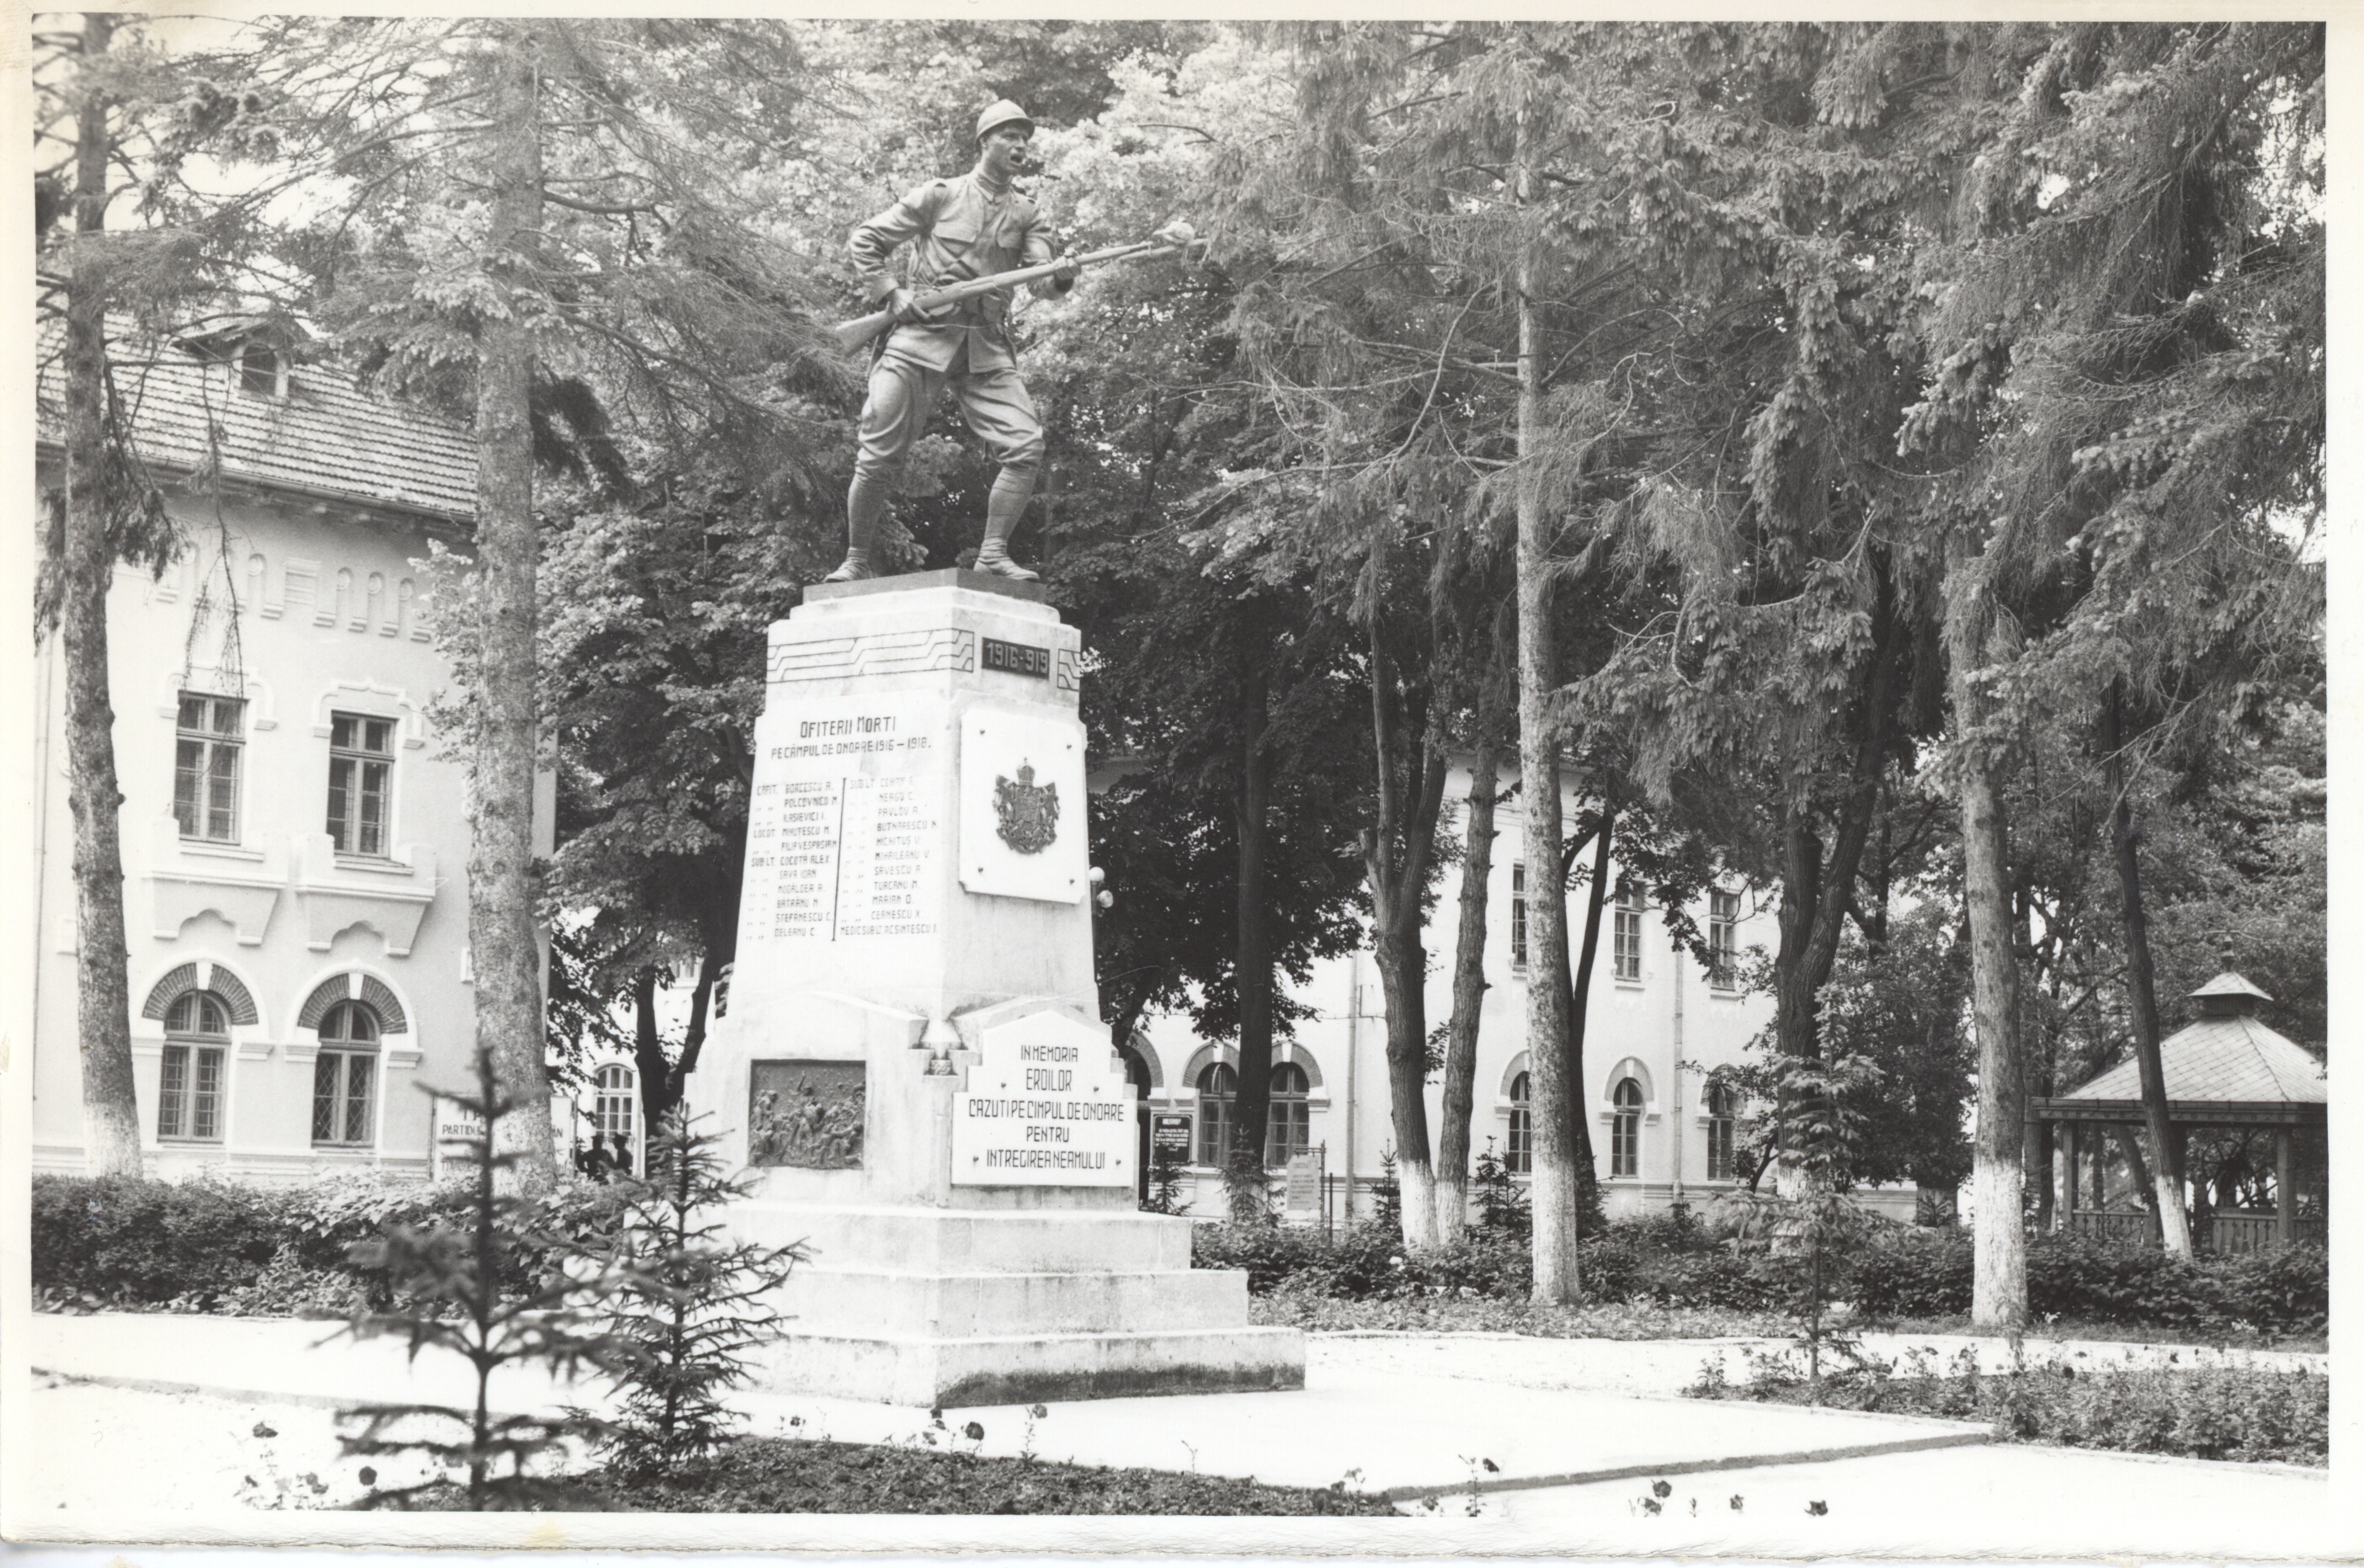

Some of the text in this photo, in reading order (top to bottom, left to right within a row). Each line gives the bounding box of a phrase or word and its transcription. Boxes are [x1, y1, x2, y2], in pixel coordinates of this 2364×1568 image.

[986, 642, 1048, 673] 1916-919
[800, 716, 896, 739] OFITERII MORTI
[771, 747, 783, 760] PE
[822, 744, 833, 755] DE
[836, 741, 873, 755] ONOARE
[876, 739, 895, 752] 1916
[879, 791, 905, 803] NEAGU
[877, 806, 908, 818] PAVLOV
[780, 842, 797, 852] FILIP
[779, 869, 817, 880] SAVA IOAN
[871, 895, 902, 906] MARIAN
[775, 928, 807, 938] DELEANU
[1020, 1044, 1078, 1063] IN MEMORIA
[1025, 1068, 1073, 1092] EROILOR
[969, 1098, 1125, 1122] CAZUTI PE CIMPUL DE ONOARE
[442, 1124, 484, 1135] PARTIDU
[1026, 1126, 1070, 1143] PENTRU
[986, 1149, 1105, 1169] INTREGIREA NEAMULUI
